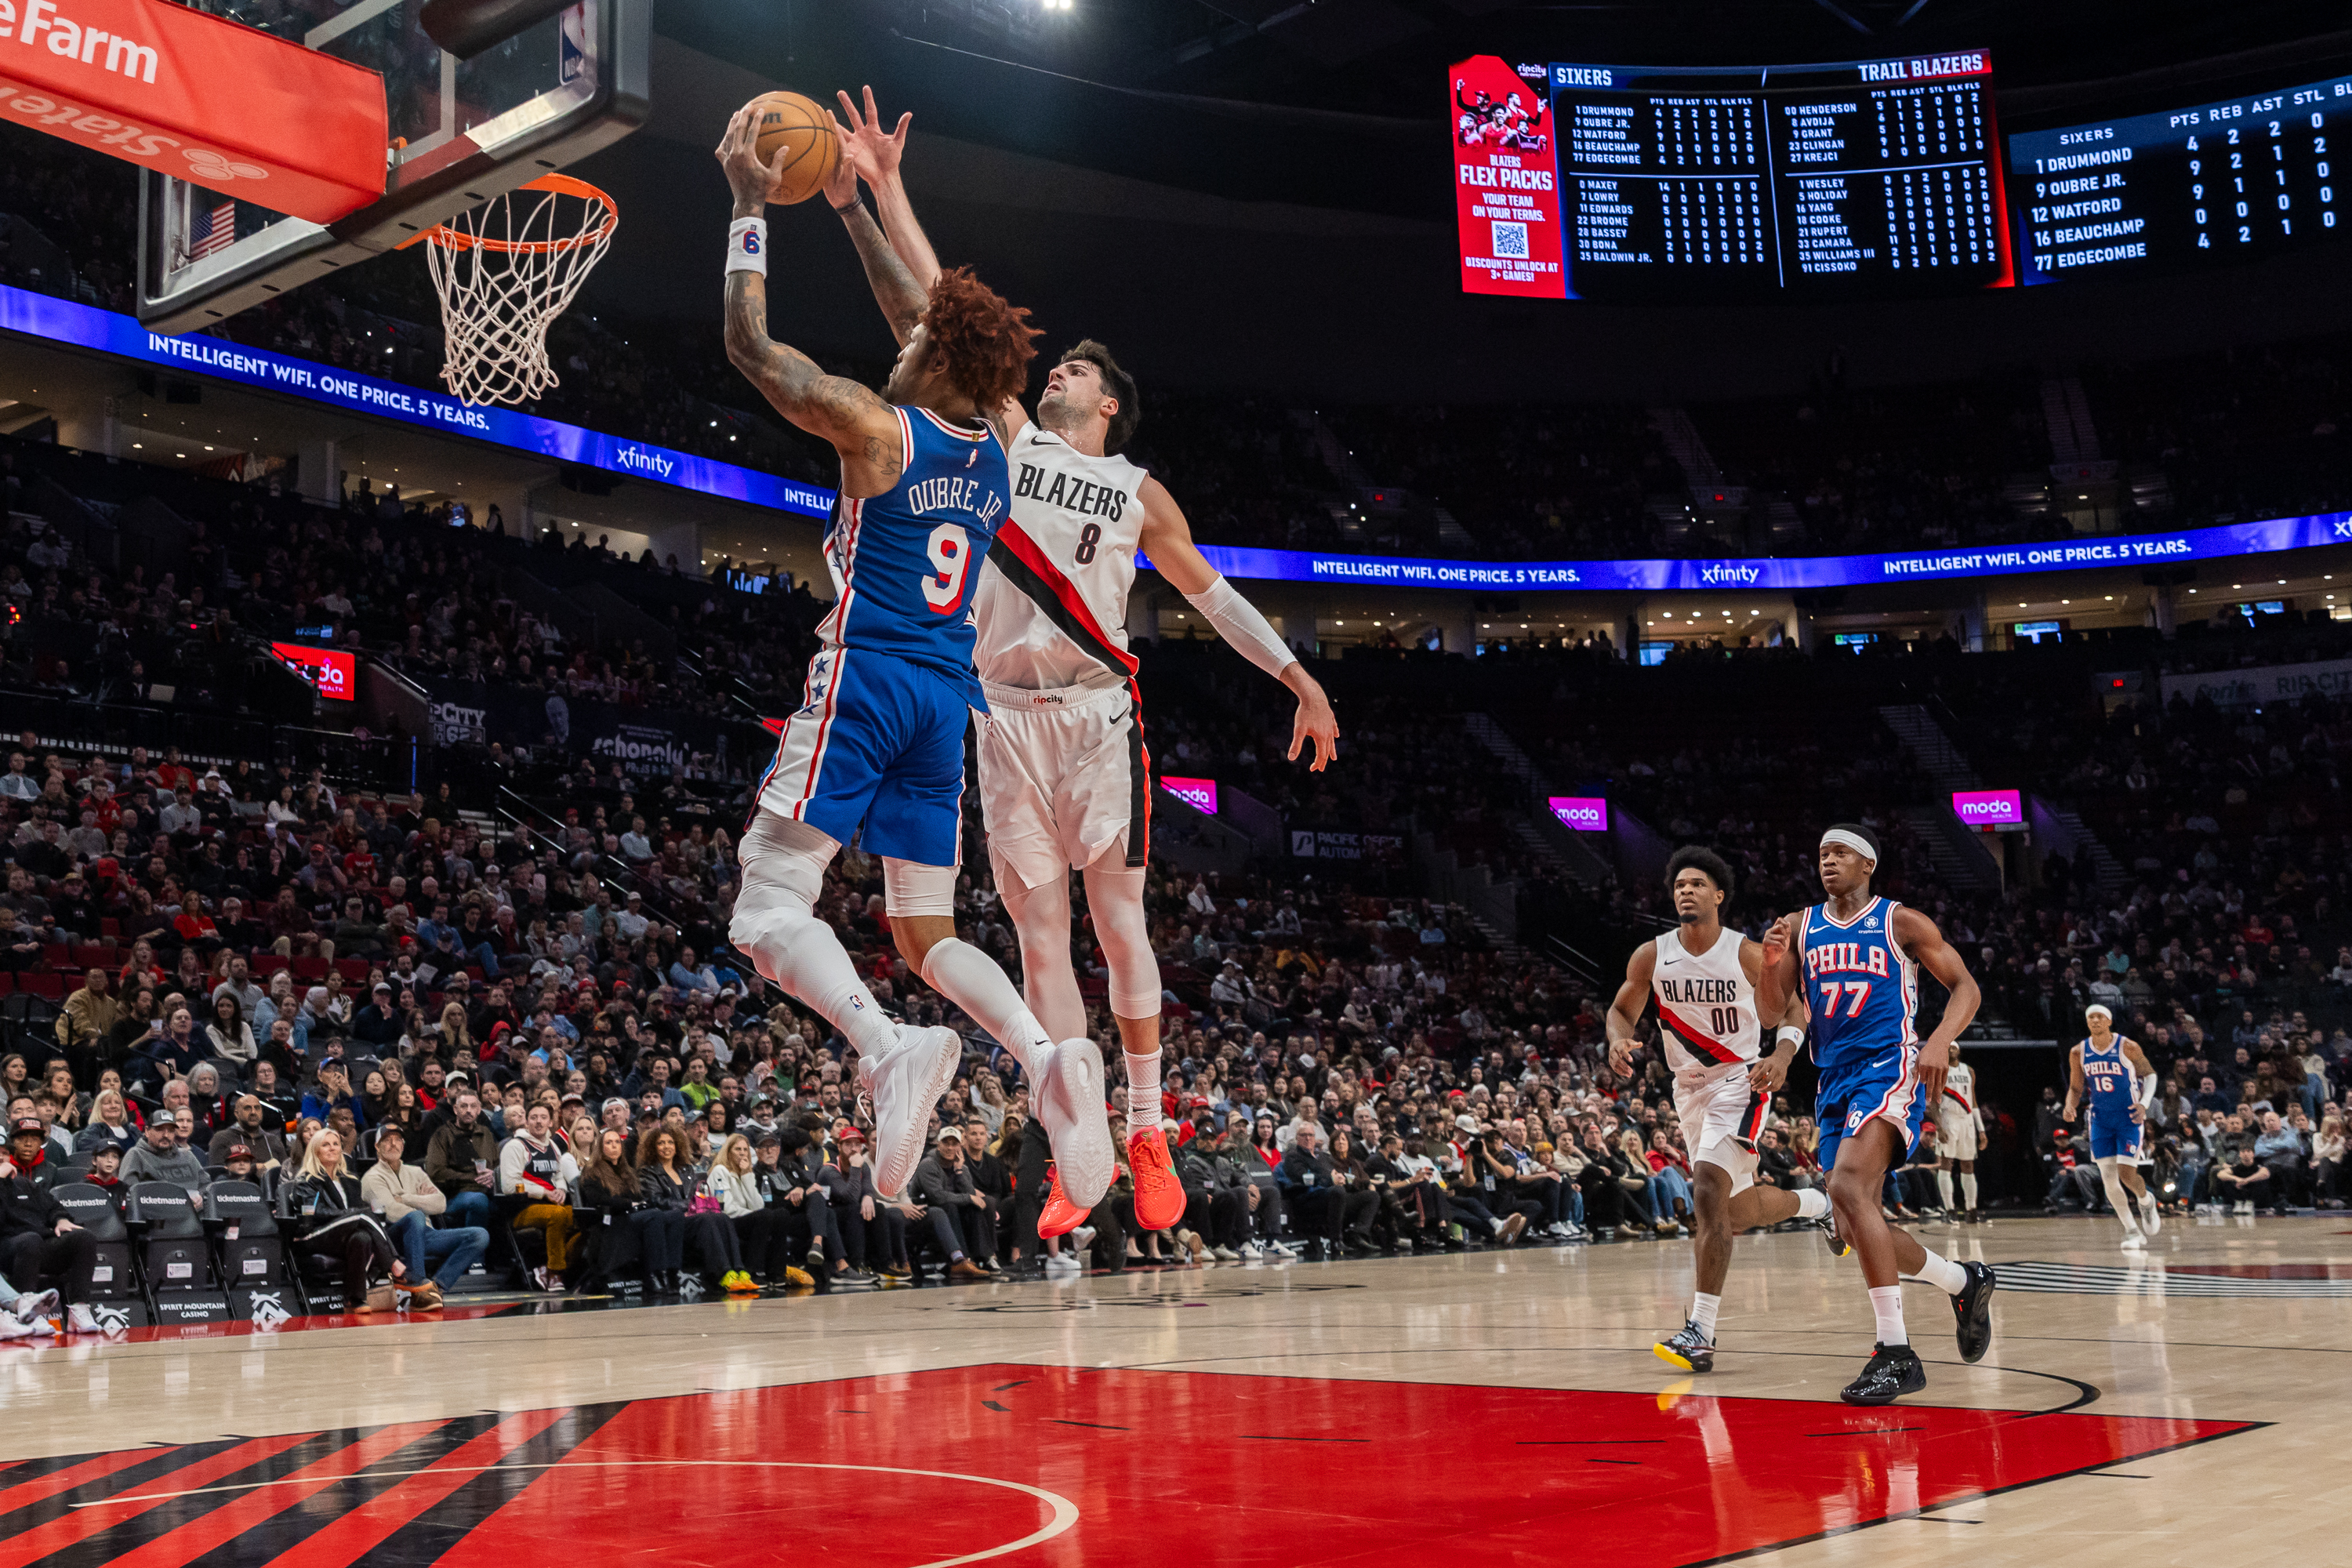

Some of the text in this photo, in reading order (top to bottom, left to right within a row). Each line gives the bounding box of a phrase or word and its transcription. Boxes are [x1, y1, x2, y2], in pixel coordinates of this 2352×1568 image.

[1858, 54, 1983, 82] TRAIL BLAZERS
[1556, 67, 1612, 86] SIXERS
[1576, 106, 1634, 116] 1 DRUMMOND
[1784, 103, 1857, 115] 00 HENDERSON
[1583, 118, 1613, 127] OUBRE
[1615, 119, 1631, 129] JR.
[1791, 117, 1835, 127] 8 AVDIJA
[2060, 128, 2114, 145] SIXERS
[2170, 113, 2200, 128] PTS
[2210, 105, 2242, 122] REB
[2252, 96, 2284, 114] AST
[2294, 90, 2325, 104] STL
[1572, 129, 1626, 140] 12 WATFORD
[1801, 129, 1832, 138] GRANT
[1573, 141, 1640, 152] 16 BEAUCHAMP
[1789, 140, 1844, 151] 23 CLINGAN
[2035, 113, 2323, 173] 1 DRUMMOND 4 2 2 0
[1490, 154, 1521, 169] BLAZERS
[1573, 153, 1640, 164] 77 EDGECOMBE
[1791, 152, 1838, 162] 27 KREJCI
[2036, 138, 2325, 198] 9 OUBRE JR. 9 2 1 2
[1460, 165, 1553, 191] FLEX PACKS
[1588, 180, 1617, 190] MAXEY
[1799, 179, 1843, 188] 1 WESLEY
[1483, 193, 1533, 208] YOUR TEAM
[1581, 192, 1619, 201] 7 LOWRY
[1798, 191, 1848, 201] 5 HOLIDAY
[1472, 205, 1545, 221] ON YOUR TERMS.
[1580, 204, 1633, 214] 11 EDWARDS
[1796, 203, 1833, 212] 16 YANG
[2032, 198, 2122, 223] 12 WATFORD
[1577, 216, 1628, 226] 22 BROOME
[1809, 215, 1842, 223] COOKE
[1577, 228, 1627, 238] 28 BASSEY
[1798, 226, 1848, 237] 21 RUPERT
[2035, 219, 2144, 246] 16 BEAUCHAMP
[743, 230, 760, 254] 6
[1579, 240, 1617, 250] 30 BONA
[1798, 238, 1853, 249] 33 CAMARA
[1580, 252, 1653, 263] 35 BALDWIN JR.
[1799, 252, 1811, 260] 35
[1813, 249, 1860, 260] WILLIAMS
[2035, 243, 2146, 271] 77 EDGECOMBE
[1465, 257, 1558, 273] DISCOUNTS UNLOCK AT
[1802, 262, 1857, 273] 91 CISSOKO
[1503, 270, 1534, 282] GAMES!
[149, 333, 489, 430] INTELLIGENT WIFI. ONE PRICE. 5 YEARS.
[618, 447, 673, 477] xfinity
[1014, 462, 1127, 522] BLAZERS
[786, 488, 835, 511] INTELLI
[909, 477, 1002, 530] OUBRE JR
[1075, 523, 1102, 565] 8
[1884, 539, 2192, 575] INTELLIGENT WIFI. ONE PRICE. 5 YEARS.
[921, 522, 972, 616] 9
[1313, 561, 1580, 583] INTELLIGENT WIFI. ONE PRICE. 5 YEARS.
[1702, 564, 1759, 584] xfinity
[1033, 695, 1063, 705] ripcity
[1558, 807, 1599, 820] moda
[1962, 800, 2012, 815] moda
[1806, 942, 1889, 980] PHILA
[1661, 979, 1736, 1003] BLAZERS
[1820, 982, 1872, 1018] 77
[1710, 1007, 1740, 1036] 00
[2084, 1062, 2122, 1076] PHILA
[2094, 1076, 2114, 1092] 16
[140, 1196, 187, 1205] ticketmaster
